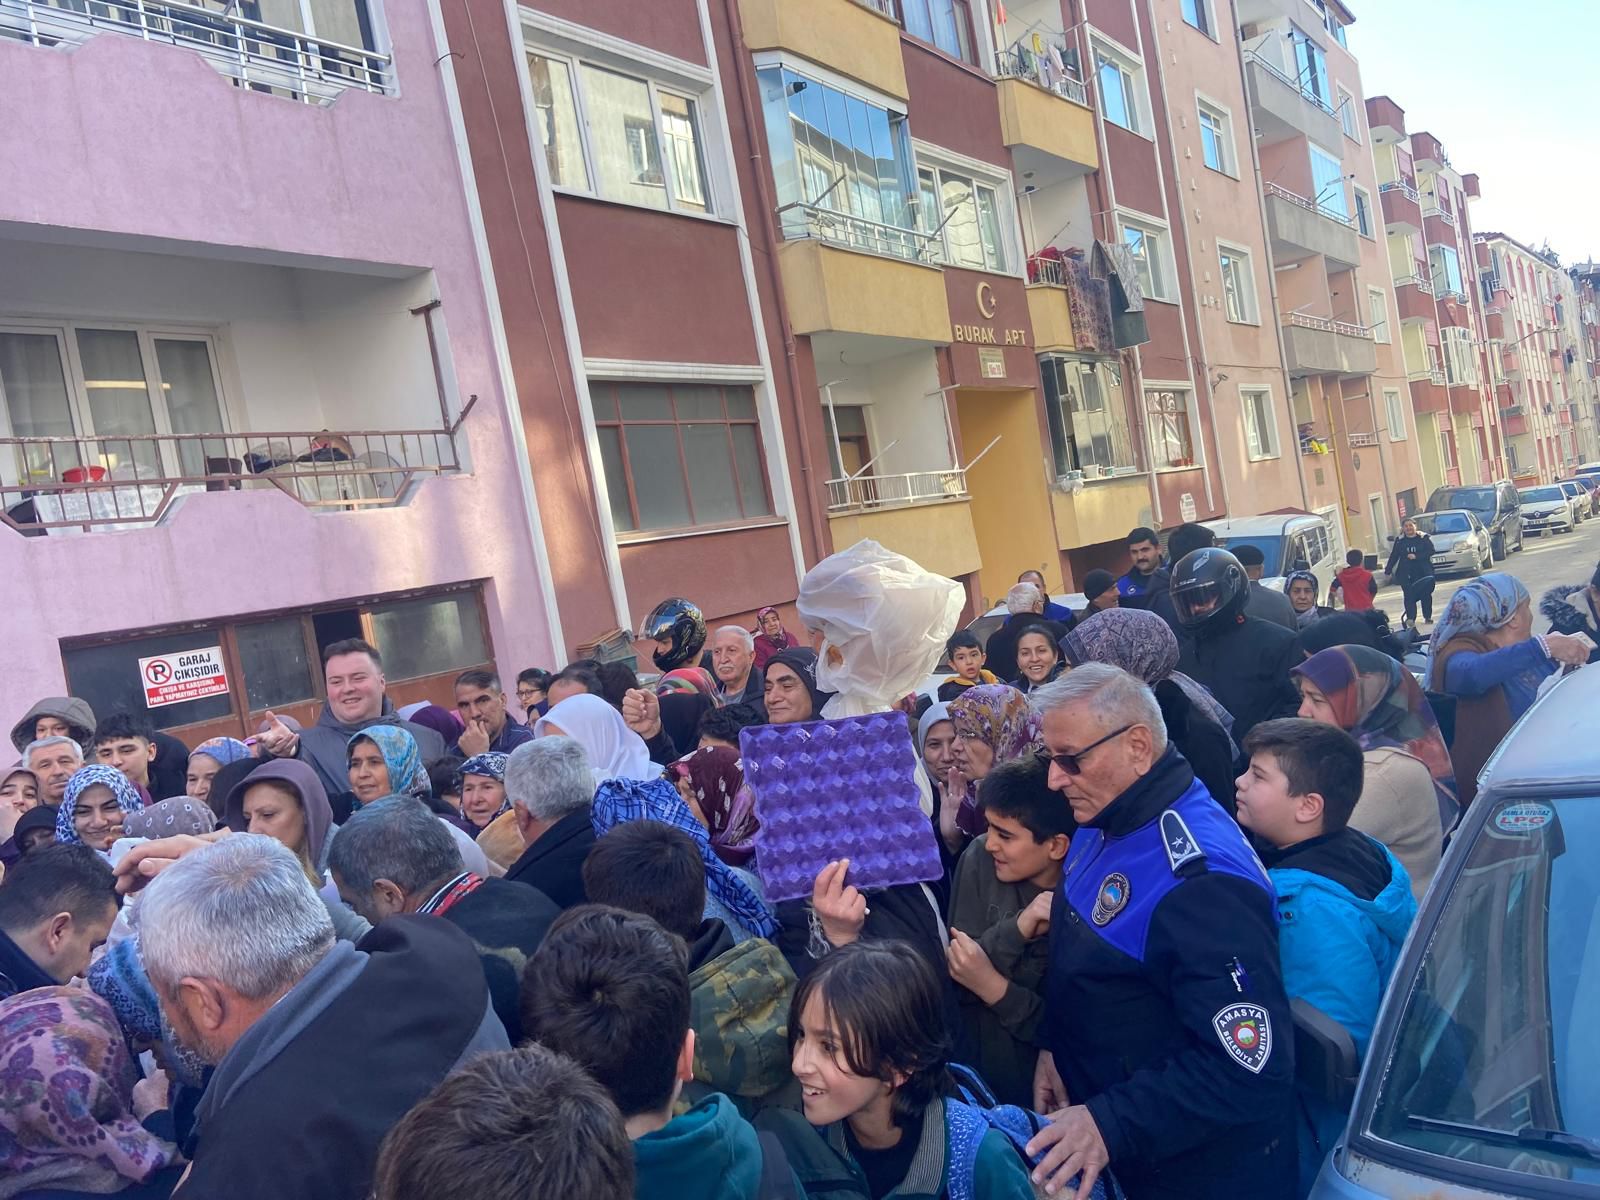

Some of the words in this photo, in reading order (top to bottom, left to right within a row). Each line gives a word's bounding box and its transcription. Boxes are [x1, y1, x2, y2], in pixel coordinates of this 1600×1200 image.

[955, 324, 997, 343] BURAK
[1005, 329, 1025, 345] APT
[179, 653, 211, 667] GARAJ
[174, 664, 220, 682] ÇIKIŞIDIR
[150, 696, 165, 704] PARK
[1500, 816, 1545, 824] LPG
[1219, 1009, 1262, 1028] AMASYA
[1223, 1030, 1253, 1064] BELEDİYE
[1255, 1024, 1266, 1061] ZABITASI
